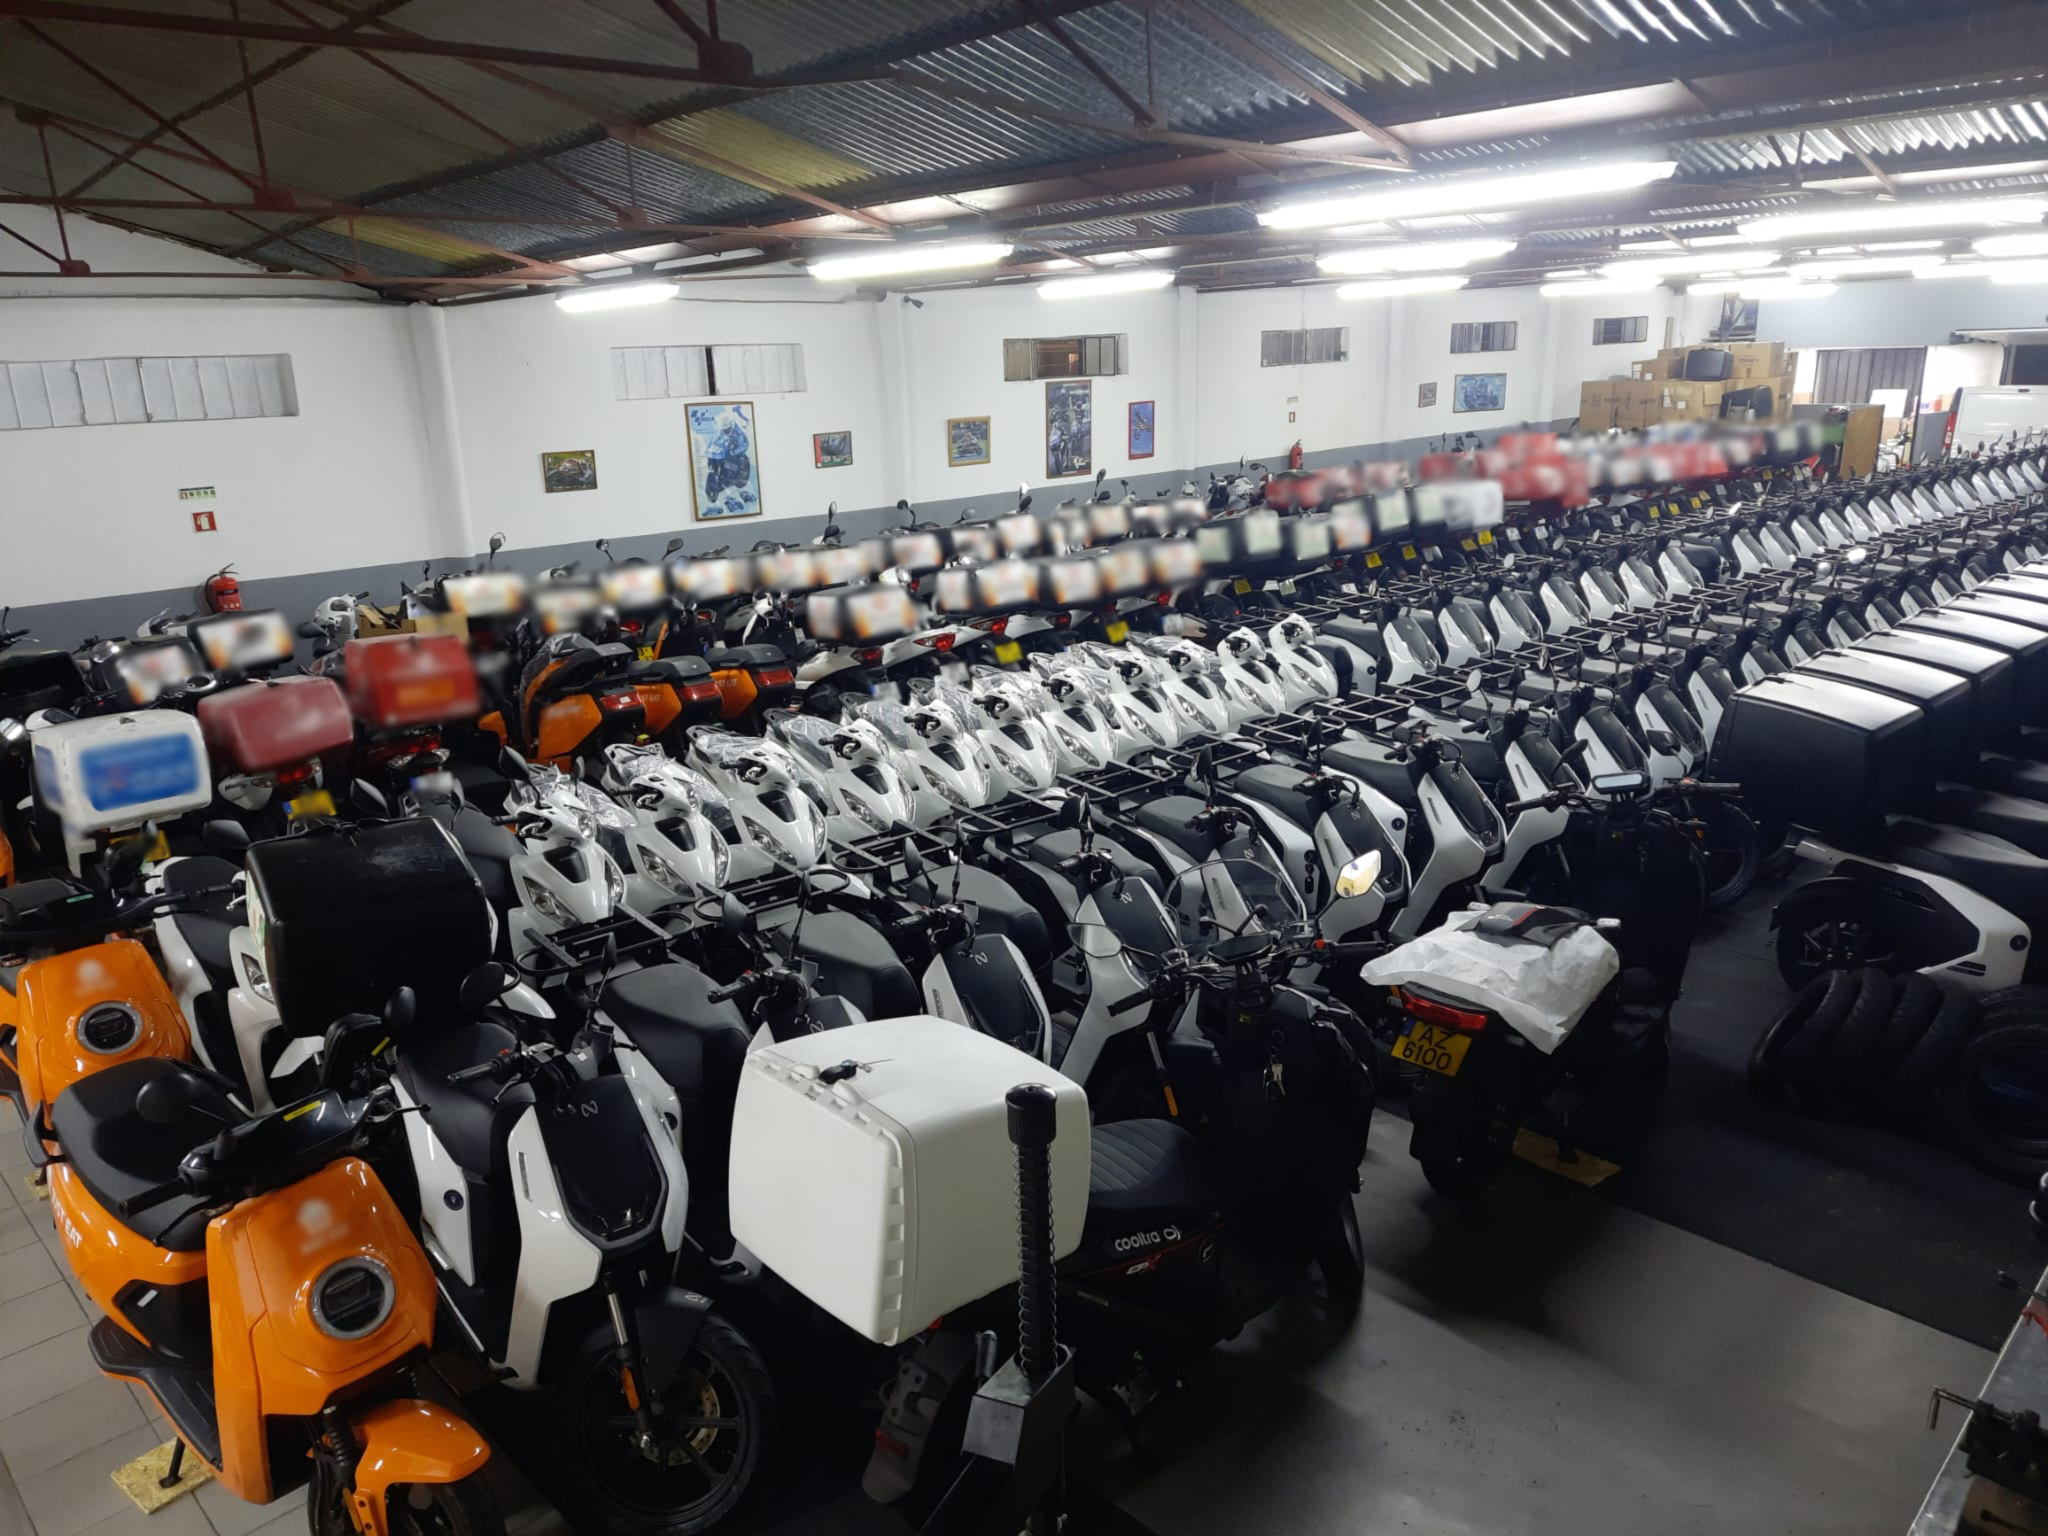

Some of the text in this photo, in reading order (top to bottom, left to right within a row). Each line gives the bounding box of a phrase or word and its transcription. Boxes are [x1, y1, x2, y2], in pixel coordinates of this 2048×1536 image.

[1418, 1026, 1453, 1050] AZ
[1402, 1041, 1452, 1070] 6100
[50, 1186, 83, 1249] UST EAT
[1114, 1230, 1161, 1252] cooltra
